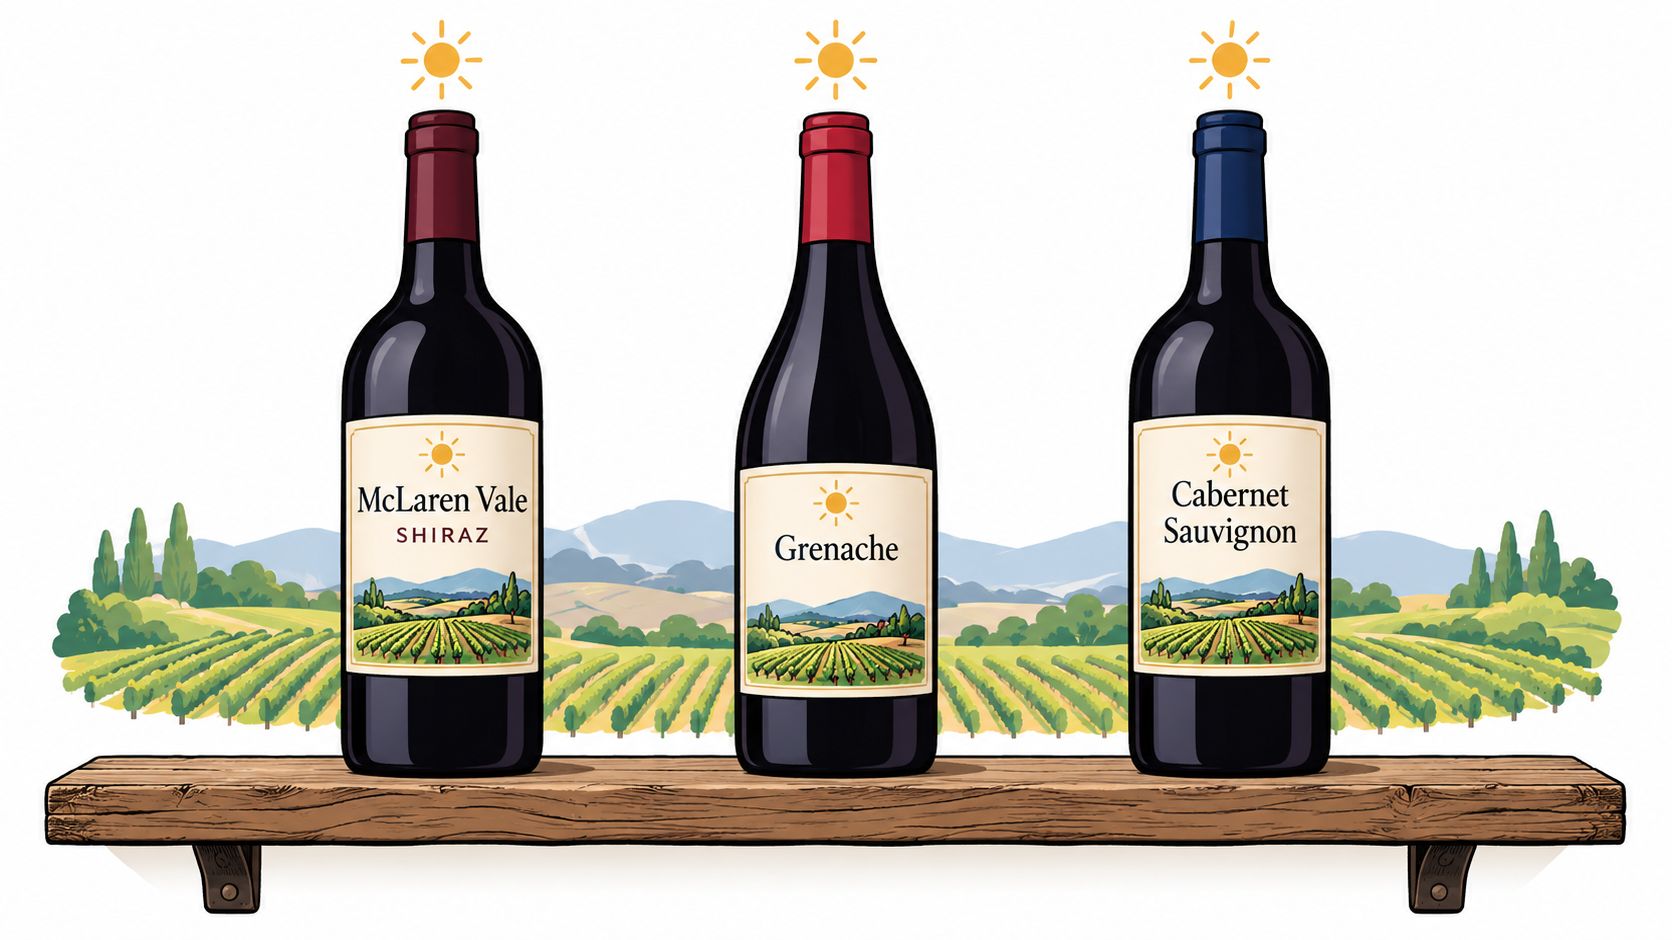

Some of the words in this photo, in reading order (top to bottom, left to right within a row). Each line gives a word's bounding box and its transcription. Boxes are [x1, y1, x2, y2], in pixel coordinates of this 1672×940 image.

[357, 486, 470, 513] McLaren
[475, 485, 528, 513] Vale
[1172, 480, 1289, 508] Cabernet
[396, 527, 489, 543] SHIRAZ
[1164, 516, 1297, 551] Sauvignon
[775, 534, 899, 562] Grenache
